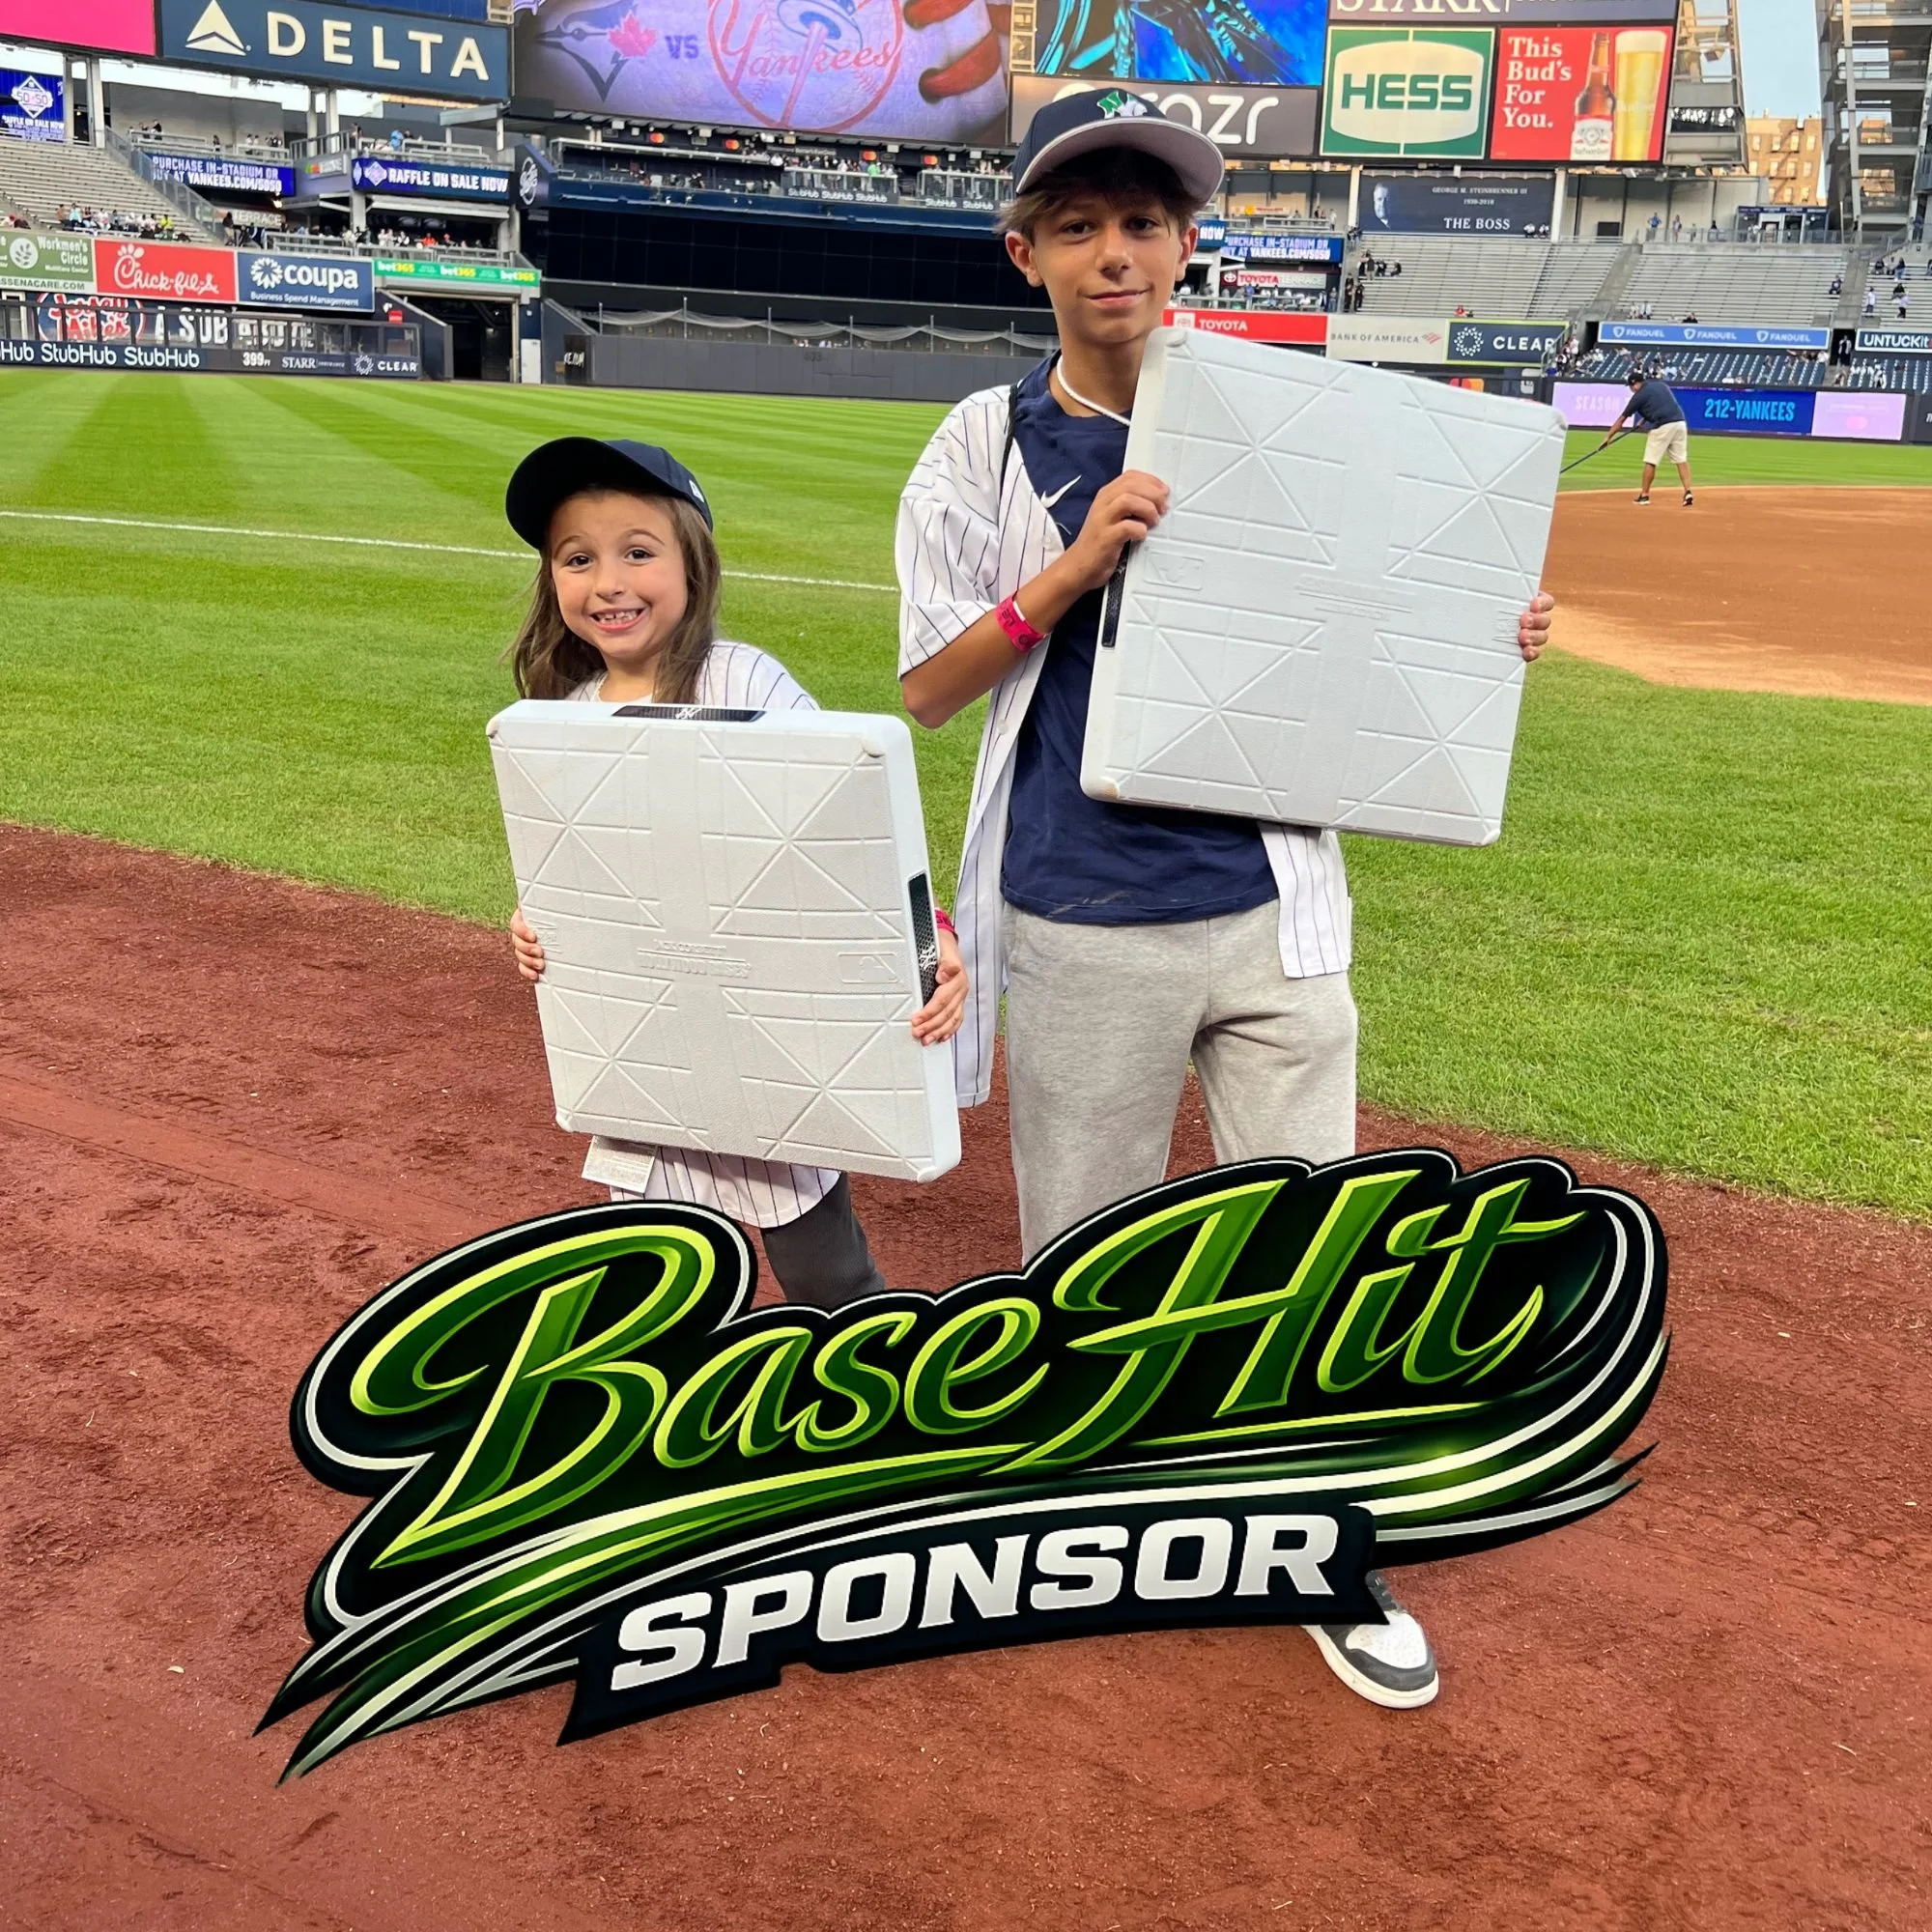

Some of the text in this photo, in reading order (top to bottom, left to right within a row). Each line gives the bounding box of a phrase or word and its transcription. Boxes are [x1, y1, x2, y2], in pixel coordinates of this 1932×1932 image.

[267, 12, 490, 81] DELTA
[665, 34, 699, 60] VS
[1508, 37, 1563, 58] This
[1506, 60, 1573, 82] Bud's
[1341, 73, 1472, 111] HESS
[1504, 84, 1546, 104] For
[1502, 107, 1554, 128] You.
[152, 156, 279, 179] PURCHASE IN-STADIUM OR
[387, 167, 509, 192] RAFFLE ON SALE NOW
[233, 209, 283, 227] TERRACE
[1443, 217, 1511, 230] THE BOSS
[1199, 226, 1225, 241] NOW
[37, 236, 88, 252] Workmen's
[60, 251, 88, 266] Circle
[114, 243, 220, 295] Chick-fil-A
[378, 263, 414, 273] bet365
[440, 265, 476, 277] bet365
[500, 270, 536, 281] bet365
[284, 264, 358, 295] coupa
[1239, 274, 1279, 284] TOYOTA
[250, 291, 359, 307] Business Spend Management
[1198, 318, 1248, 333] TOYOTA
[1330, 333, 1420, 344] BANK OF AMERICA
[1492, 336, 1556, 352] CLEAR
[1626, 328, 1812, 343] FANDUEL FANDUEL FANDUEL
[0, 341, 201, 368] Hub StubHub StubHub
[281, 356, 317, 369] STARR
[377, 360, 418, 373] CLEAR
[1575, 394, 1620, 412] SEASON
[1704, 398, 1797, 422] 212-YANKEES
